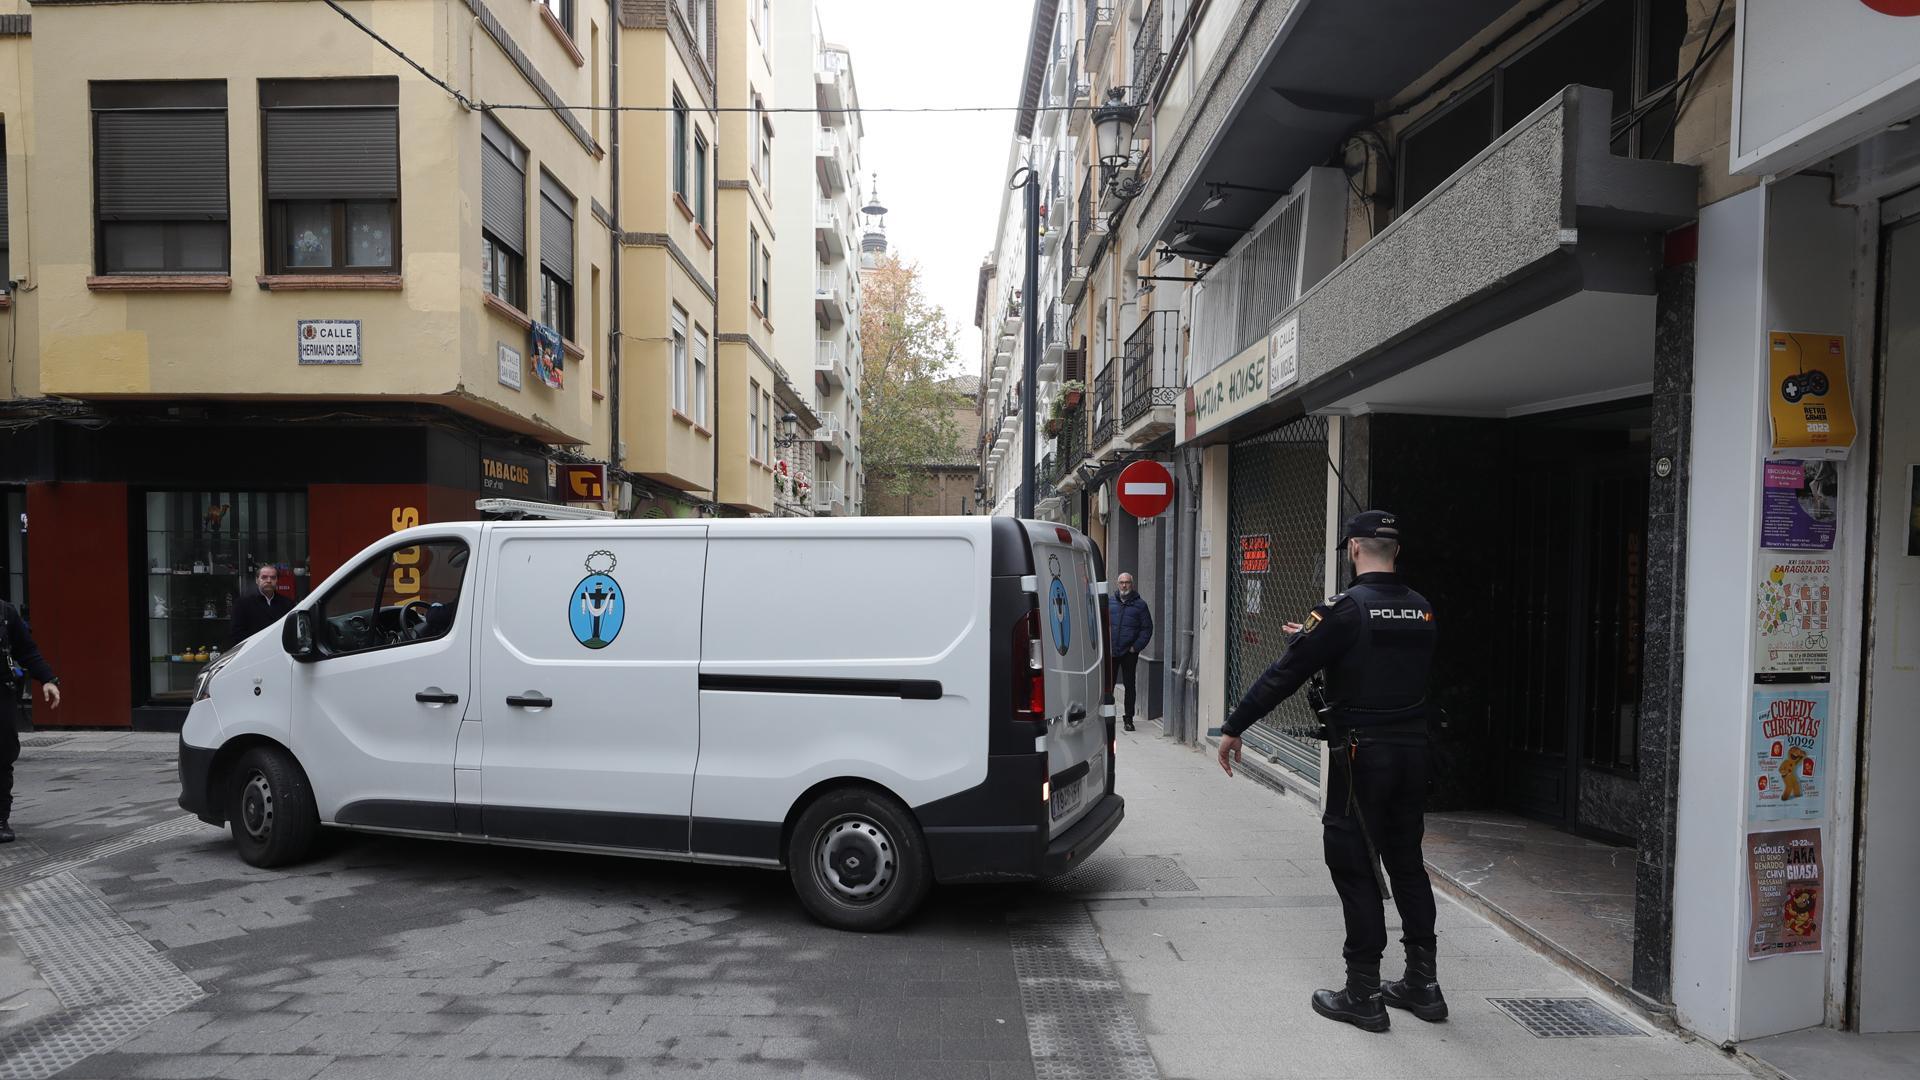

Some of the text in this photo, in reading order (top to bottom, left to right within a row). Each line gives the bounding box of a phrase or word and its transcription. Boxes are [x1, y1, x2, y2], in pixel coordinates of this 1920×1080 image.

[320, 328, 352, 338] CALLE
[1280, 327, 1295, 349] CALLE
[303, 344, 357, 356] HERMANOS IBARRA
[507, 353, 519, 367] CALLE
[1271, 355, 1295, 385] SAN MIGUEL
[1195, 355, 1266, 421] NATUR HOUSE
[1804, 407, 1826, 415] RETRO
[1806, 423, 1830, 433] 2022
[483, 458, 529, 484] TABACOS
[1774, 565, 1830, 574] ZARAGOZA 2022
[1369, 609, 1425, 620] POLICIA
[1770, 699, 1817, 719] COMEDY
[1762, 717, 1821, 739] CHRISTMAS
[1787, 736, 1815, 749] 2022
[1753, 845, 1785, 855] GANDULES
[1754, 861, 1785, 870] RENARDO
[1786, 864, 1818, 880] GUASA
